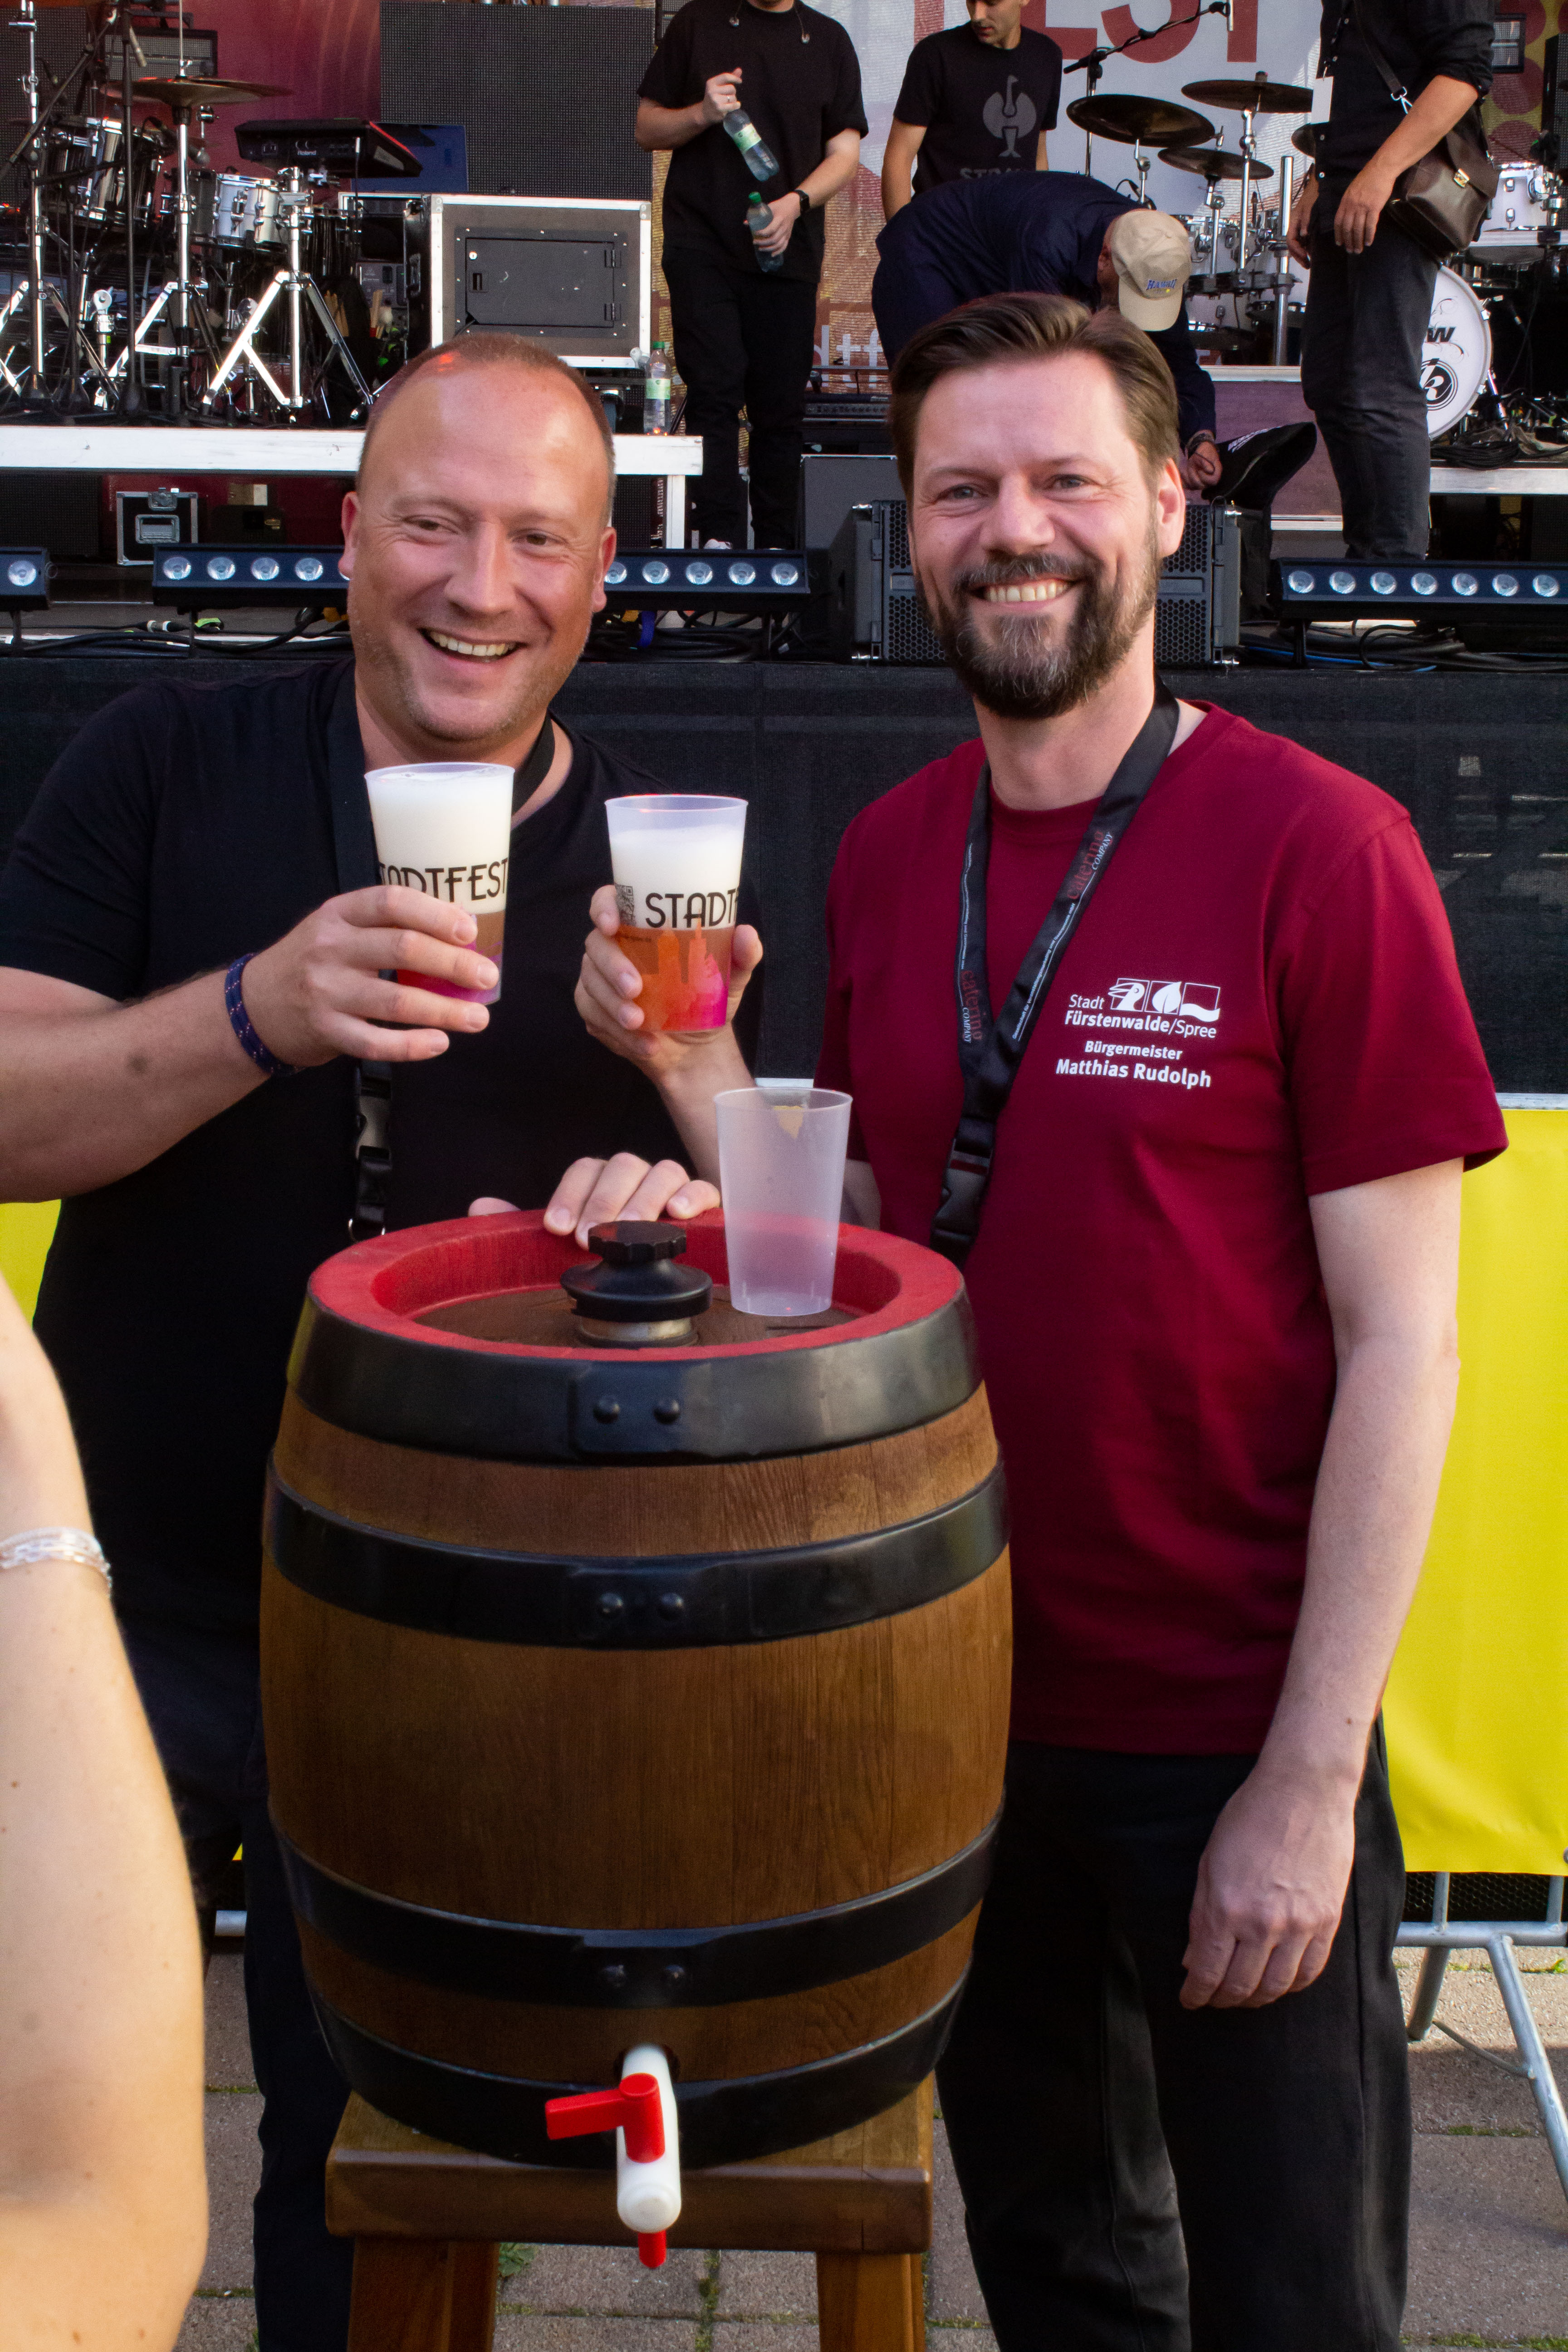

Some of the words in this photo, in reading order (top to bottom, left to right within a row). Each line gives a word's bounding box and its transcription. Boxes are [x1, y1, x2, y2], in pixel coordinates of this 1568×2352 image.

[1092, 831, 1113, 870] COMPANY
[1068, 994, 1105, 1009] Stadt
[962, 1007, 971, 1044] COMPANY
[1064, 1010, 1217, 1038] Fürstenwalde/Spree
[1084, 1040, 1183, 1060] Bürgermeister
[1055, 1058, 1129, 1078] Matthias
[1133, 1063, 1211, 1089] Rudolph
